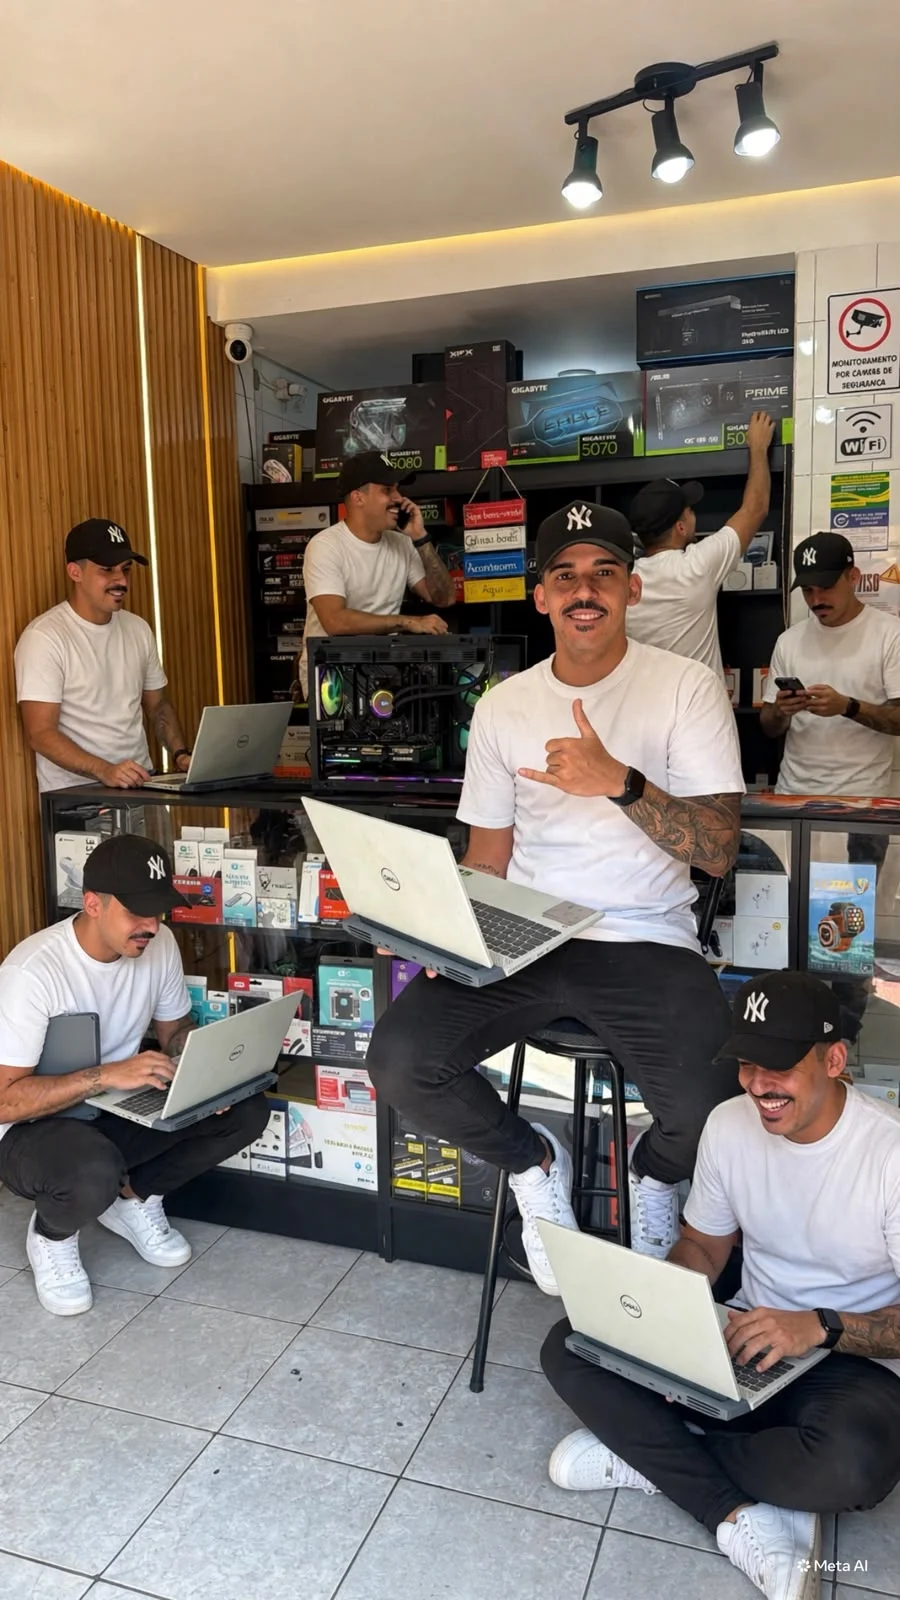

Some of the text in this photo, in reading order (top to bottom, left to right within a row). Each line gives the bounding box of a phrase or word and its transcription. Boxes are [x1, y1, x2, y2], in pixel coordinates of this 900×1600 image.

[836, 370, 850, 378] POR
[512, 385, 548, 394] GIGABYTE
[745, 386, 788, 398] PRIME
[727, 431, 748, 446] 50
[582, 441, 617, 456] 5070
[567, 505, 592, 530] NY
[107, 525, 124, 543] NY
[803, 547, 816, 566] NY
[855, 573, 880, 592] VISO
[147, 854, 166, 880] NY
[743, 991, 769, 1022] NY
